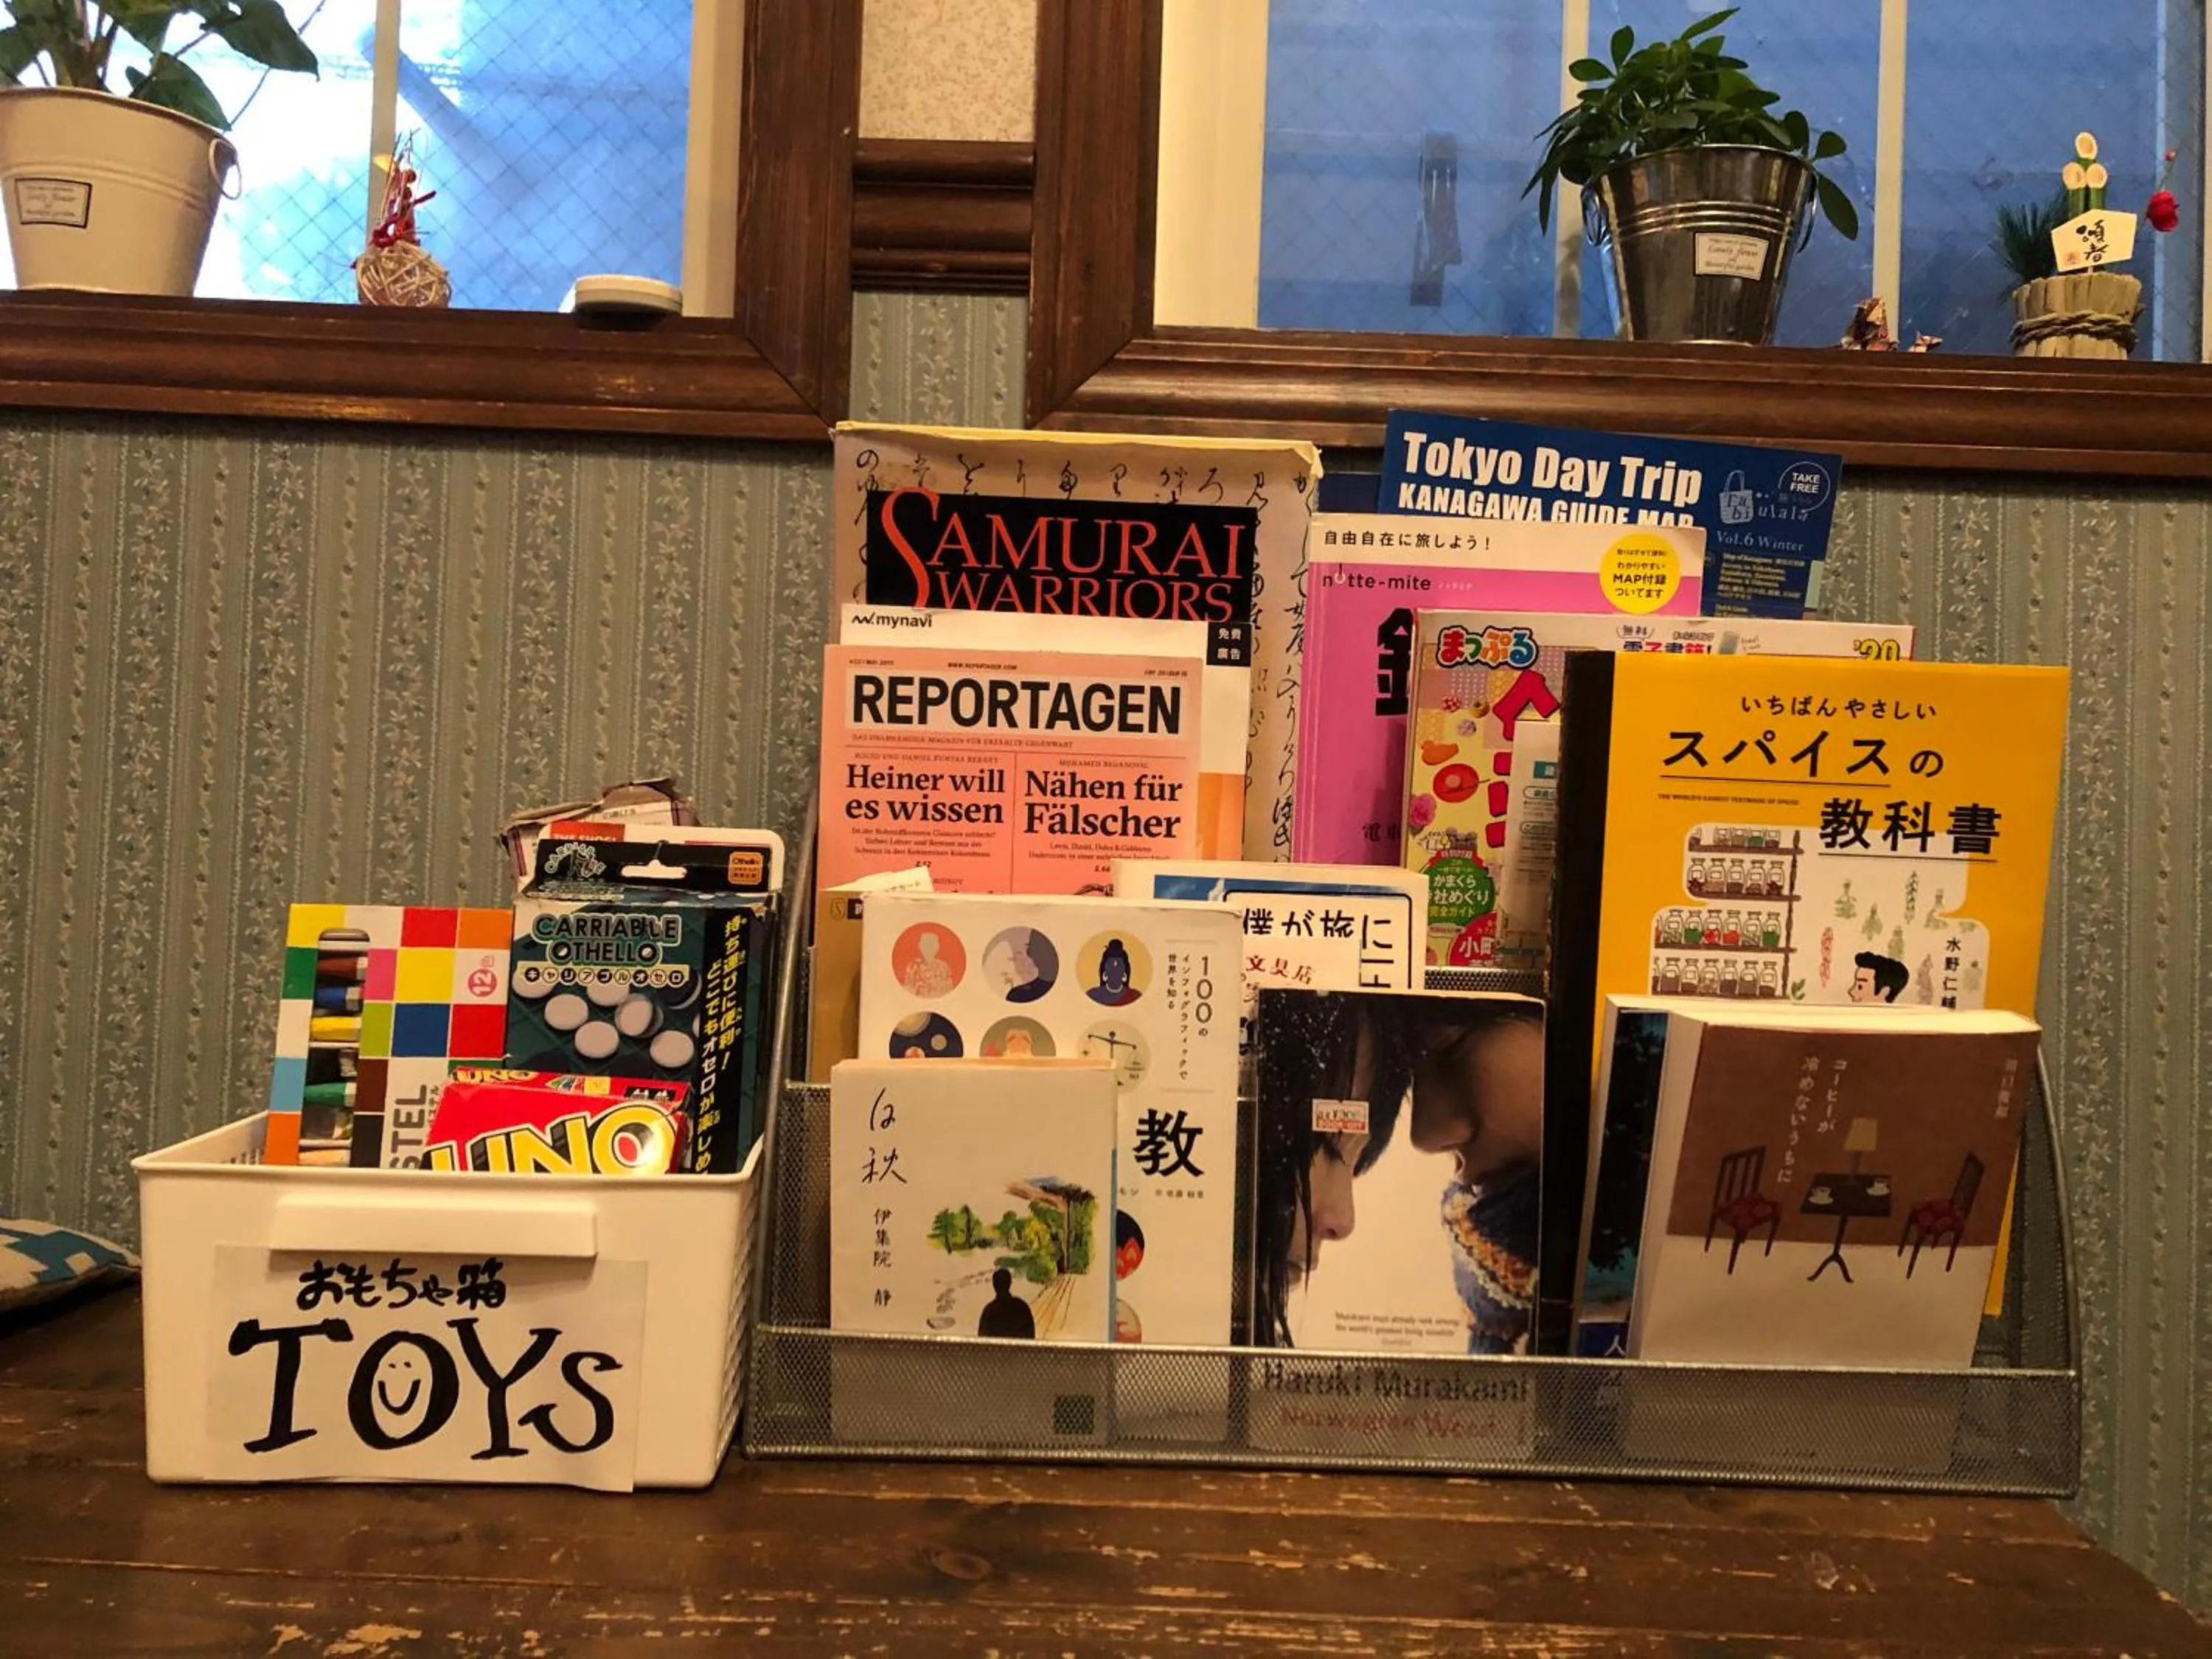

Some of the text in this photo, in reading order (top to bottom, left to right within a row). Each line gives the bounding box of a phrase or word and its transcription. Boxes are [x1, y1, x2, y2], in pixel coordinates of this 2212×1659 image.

[1403, 431, 1703, 507] Tokyo Day Trip
[1790, 472, 1821, 494] TAKE FREE
[1398, 483, 1694, 528] KANAGAWA GUIDE MAP
[881, 485, 1245, 609] SAMURAI
[1717, 530, 1804, 552] Vol.6 Winter
[936, 570, 1233, 624] WARRIORS
[876, 613, 933, 630] mynavi
[1439, 627, 1536, 667] まっぷる
[853, 674, 1181, 735] REPORTAGEN
[1741, 695, 1938, 720] いちばんやさしい
[1662, 728, 1945, 779] スパイスの
[846, 763, 1006, 793] Heiner will
[1024, 770, 1183, 801] Nähen für
[845, 793, 1004, 824] es wissen
[1023, 802, 1181, 838] Fälscher
[1820, 796, 2003, 855] 教科書
[1428, 889, 1489, 905] 社めぐり
[1433, 874, 1477, 889] かまくら
[535, 915, 680, 940] CARRIABLE
[553, 941, 658, 963] OTHELLO
[1245, 954, 1315, 985] 文具店
[456, 1068, 539, 1083] UNO
[695, 959, 722, 1178] どこでもオセロが楽しめ
[422, 1103, 678, 1175] UNO
[1133, 1107, 1205, 1178] 教
[296, 1256, 507, 1310] おもちゃ箱
[228, 1317, 623, 1461] TOYS
[1264, 1360, 1528, 1402] Haruki Murakami
